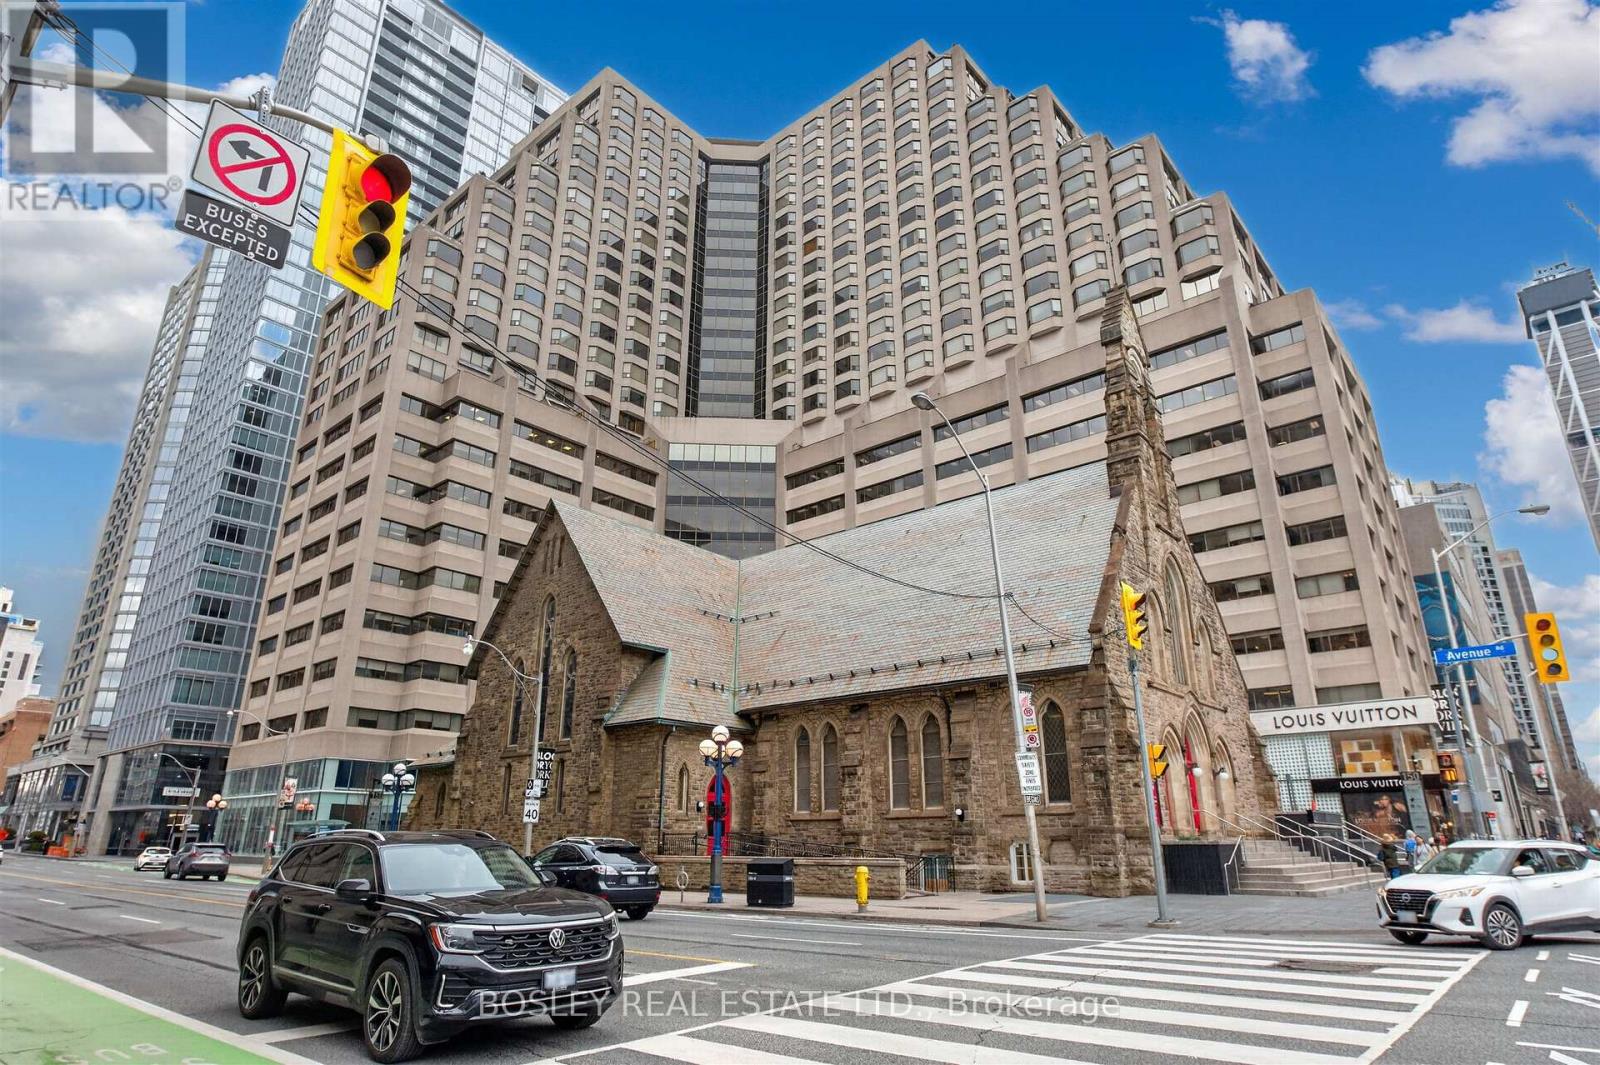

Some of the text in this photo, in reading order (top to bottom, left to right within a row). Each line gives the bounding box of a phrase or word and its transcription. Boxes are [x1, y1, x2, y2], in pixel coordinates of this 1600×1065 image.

[205, 202, 269, 239] BUSES
[183, 212, 280, 262] EXCEPTED
[1446, 648, 1491, 660] Avenue
[1273, 704, 1417, 730] LOUIS VUITTON
[1340, 780, 1369, 789] LOUIS
[525, 809, 538, 820] 40
